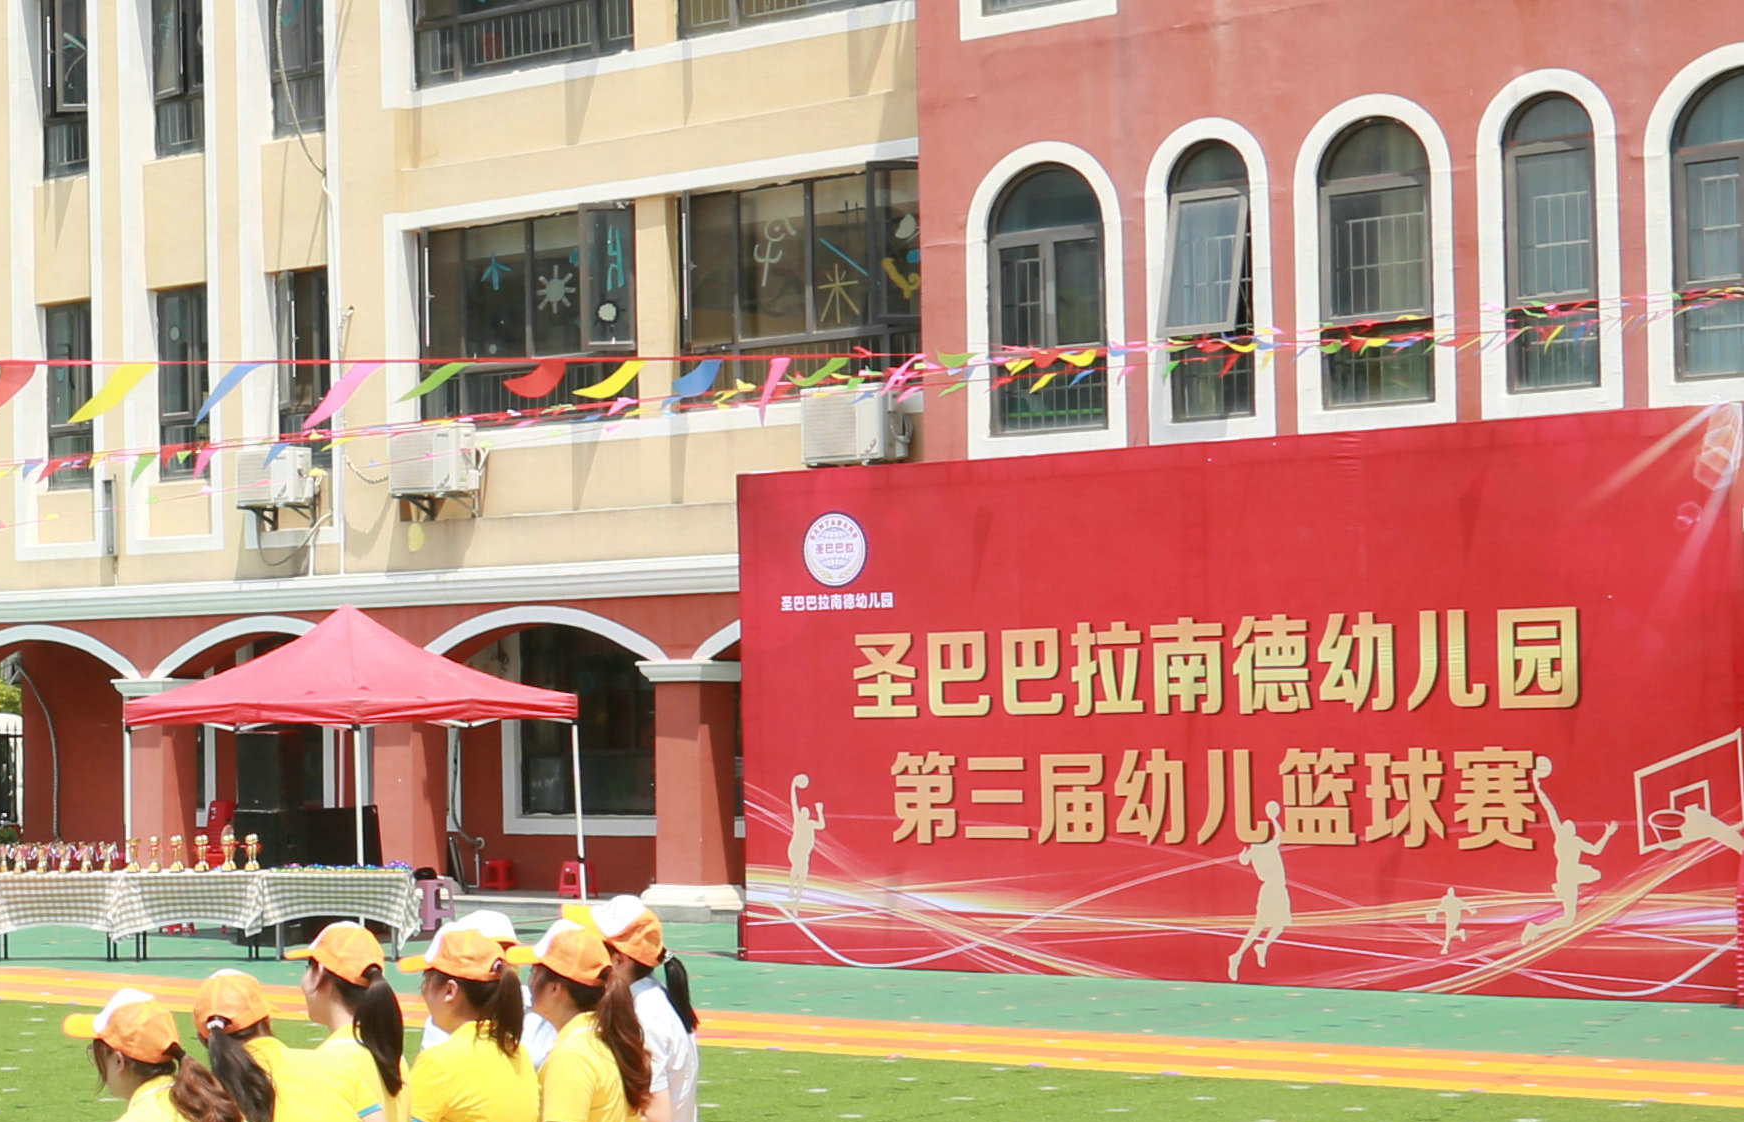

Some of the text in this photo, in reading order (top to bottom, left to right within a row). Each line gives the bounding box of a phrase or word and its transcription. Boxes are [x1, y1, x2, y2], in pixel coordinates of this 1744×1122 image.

[780, 592, 894, 612] 圣巴巴拉南德幼儿园
[853, 606, 1579, 718] 圣巴巴拉南德幼儿园
[891, 746, 1537, 850] 第三届幼儿篮球赛
